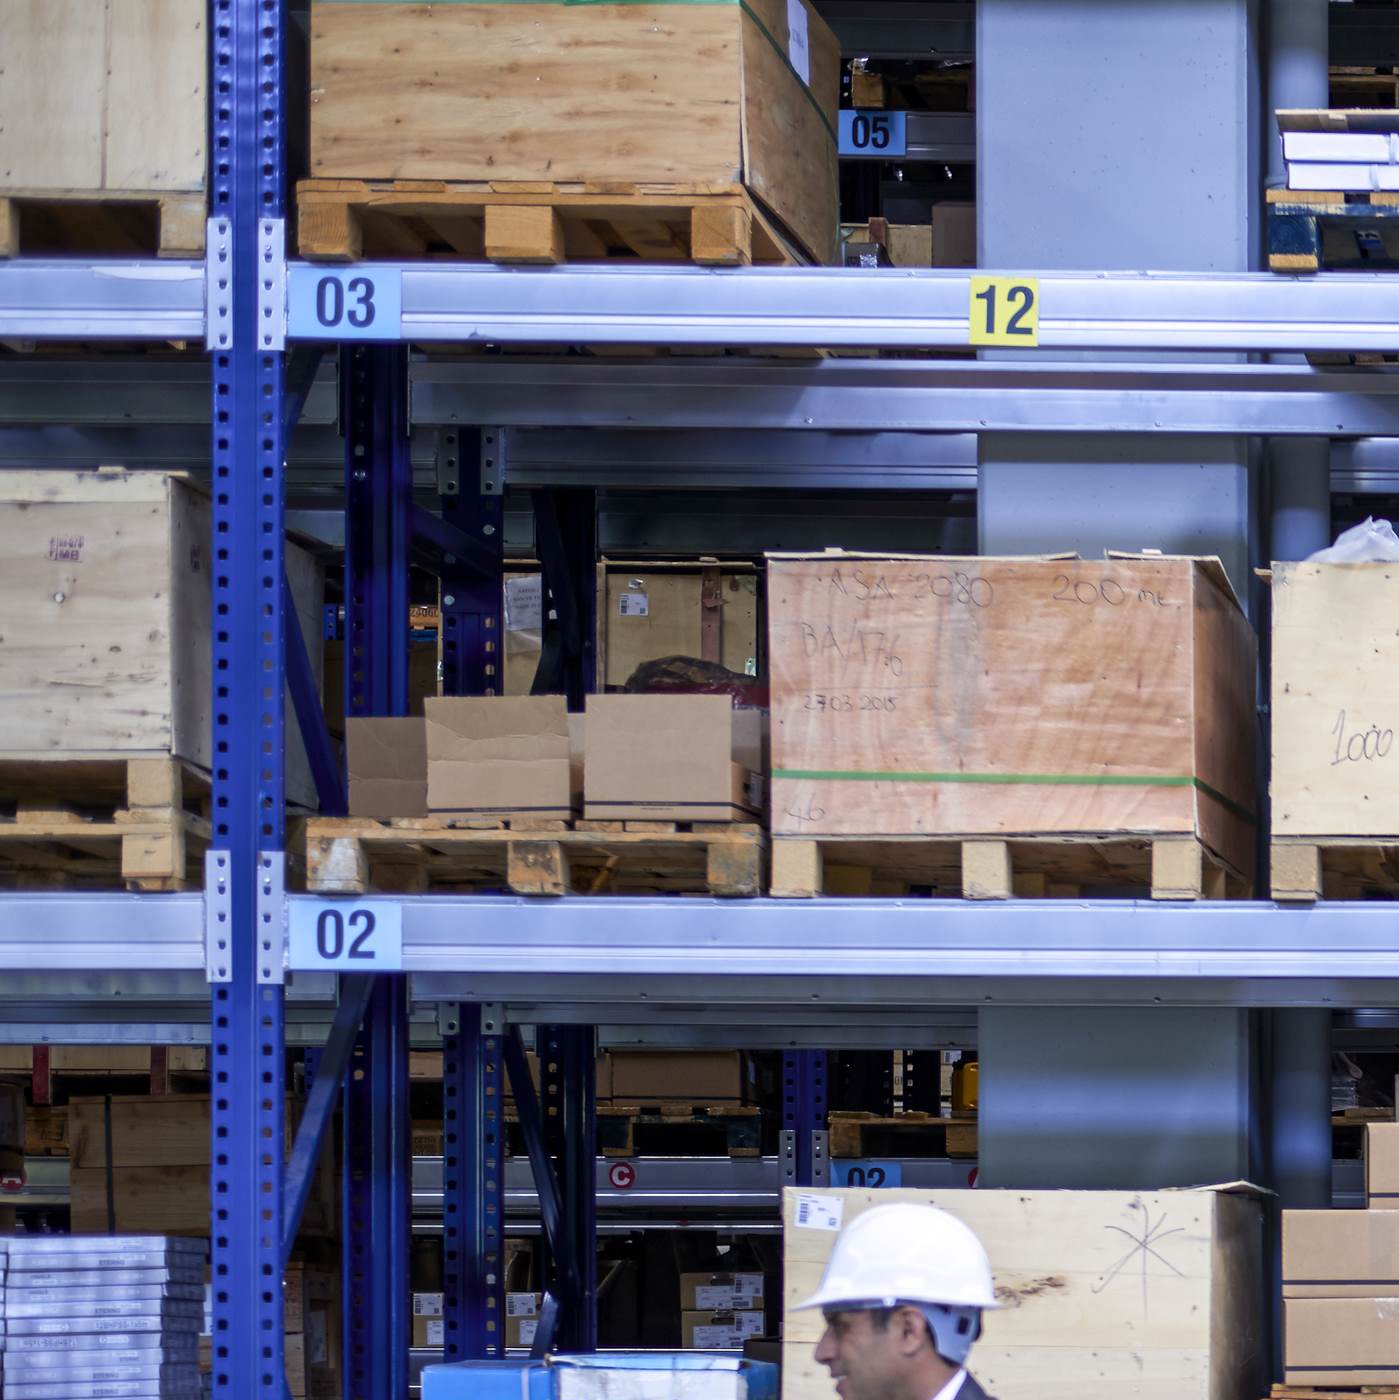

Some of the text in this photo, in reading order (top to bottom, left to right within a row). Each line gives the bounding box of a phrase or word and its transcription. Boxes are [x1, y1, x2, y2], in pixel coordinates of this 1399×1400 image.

[851, 116, 889, 148] 05
[315, 276, 376, 328] 03
[976, 286, 1034, 336] 12
[1052, 573, 1124, 607] 200
[1331, 710, 1393, 764] 1000
[315, 909, 376, 961] 02
